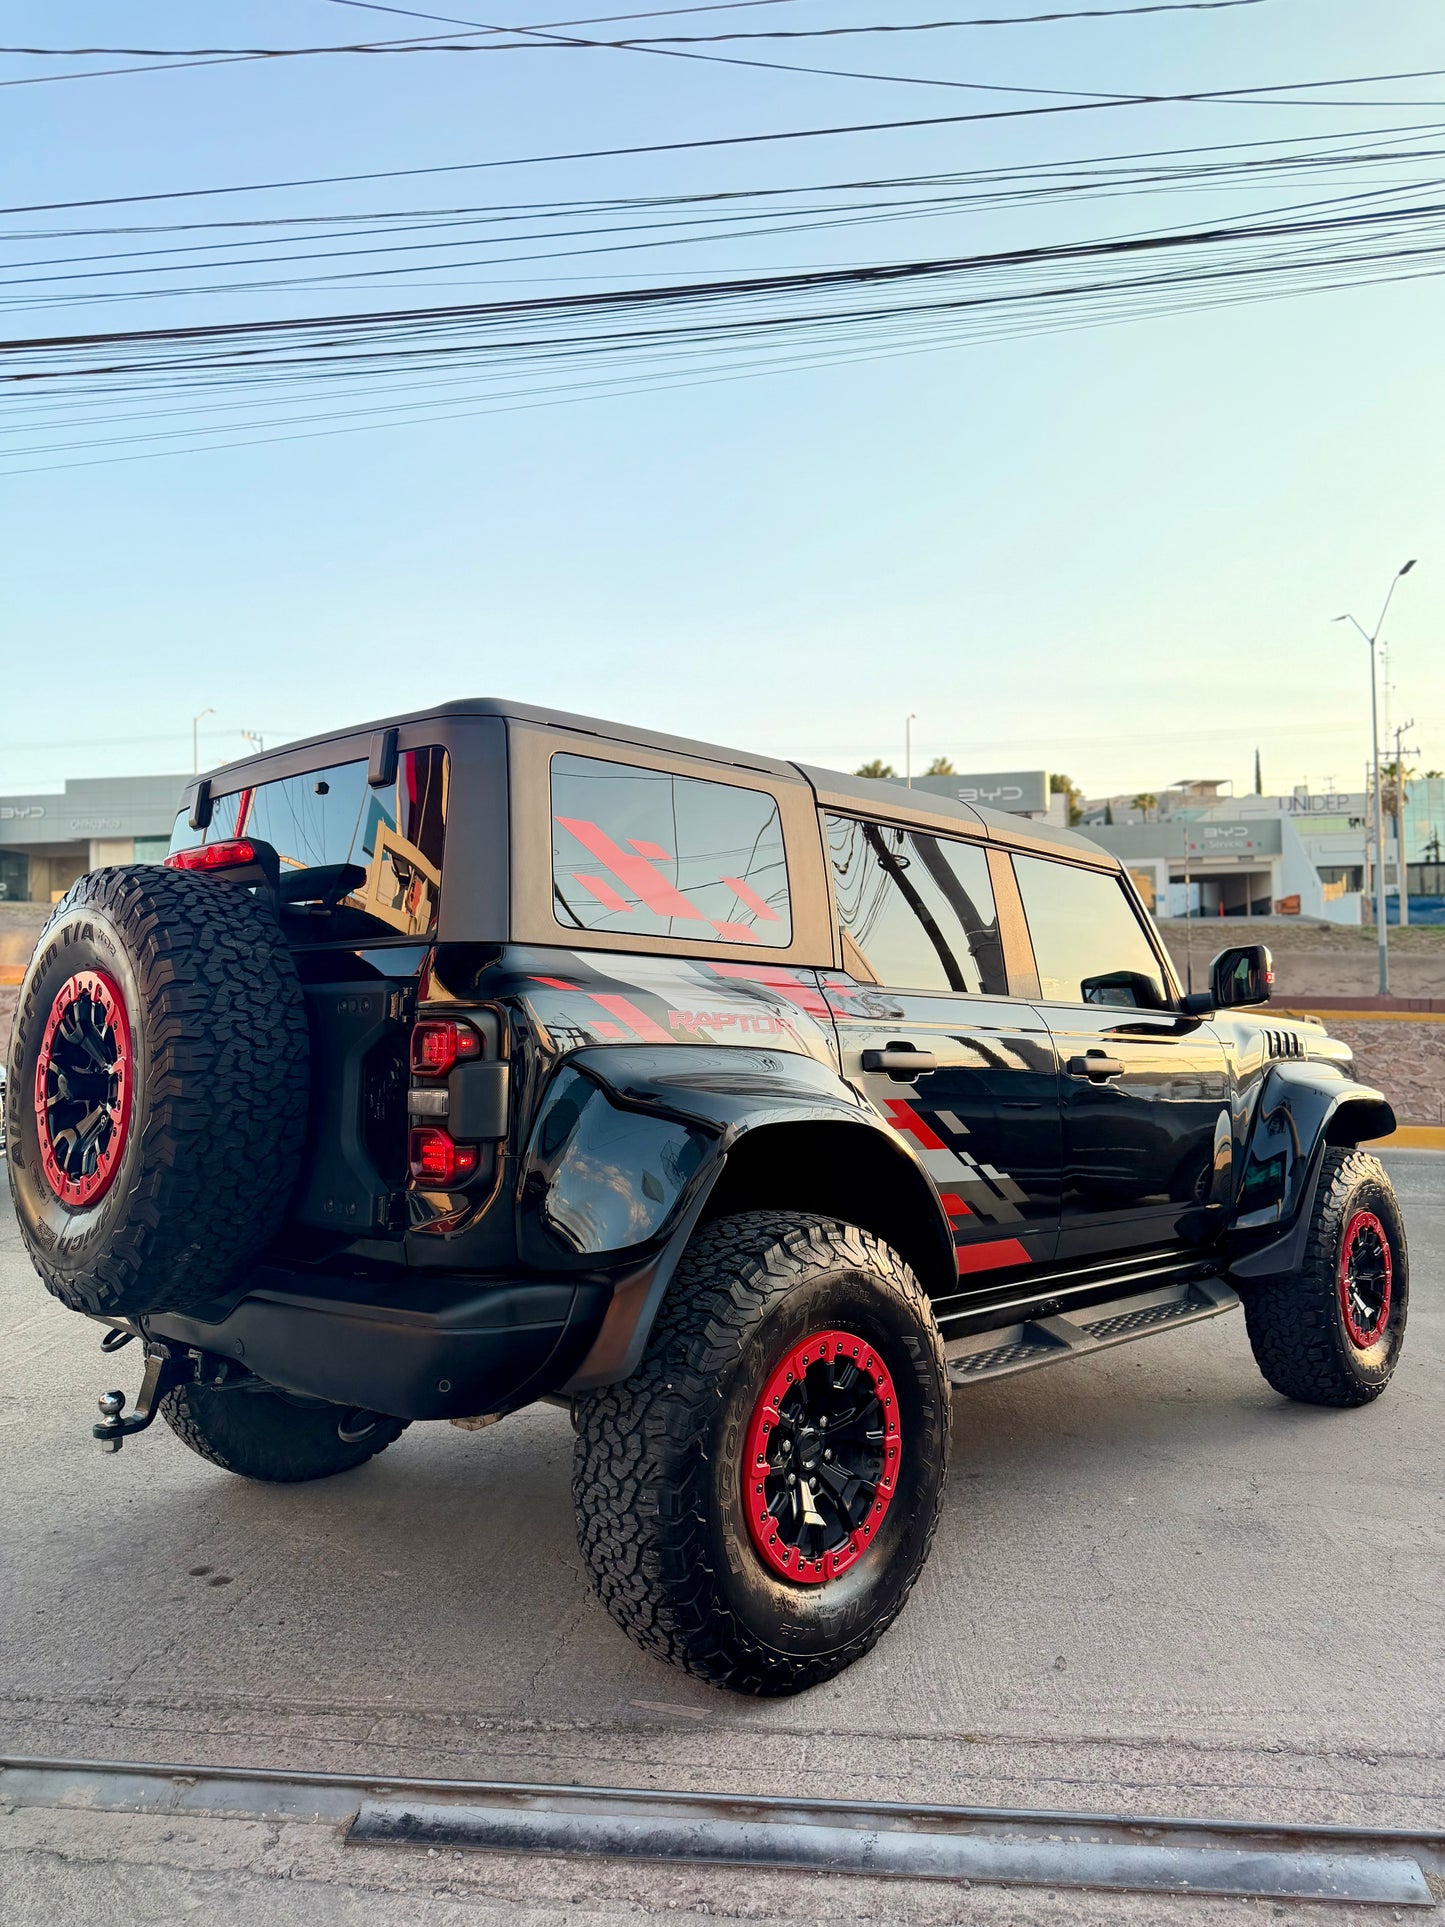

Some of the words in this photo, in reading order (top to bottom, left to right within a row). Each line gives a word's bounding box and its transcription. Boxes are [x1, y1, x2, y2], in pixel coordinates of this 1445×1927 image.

[957, 786, 1023, 801] BYD
[1278, 794, 1350, 811] UNIDEP
[0, 806, 46, 819] BYD
[1203, 826, 1249, 838] BYD
[61, 919, 95, 948] T/A
[668, 1009, 796, 1040] RAPTOR
